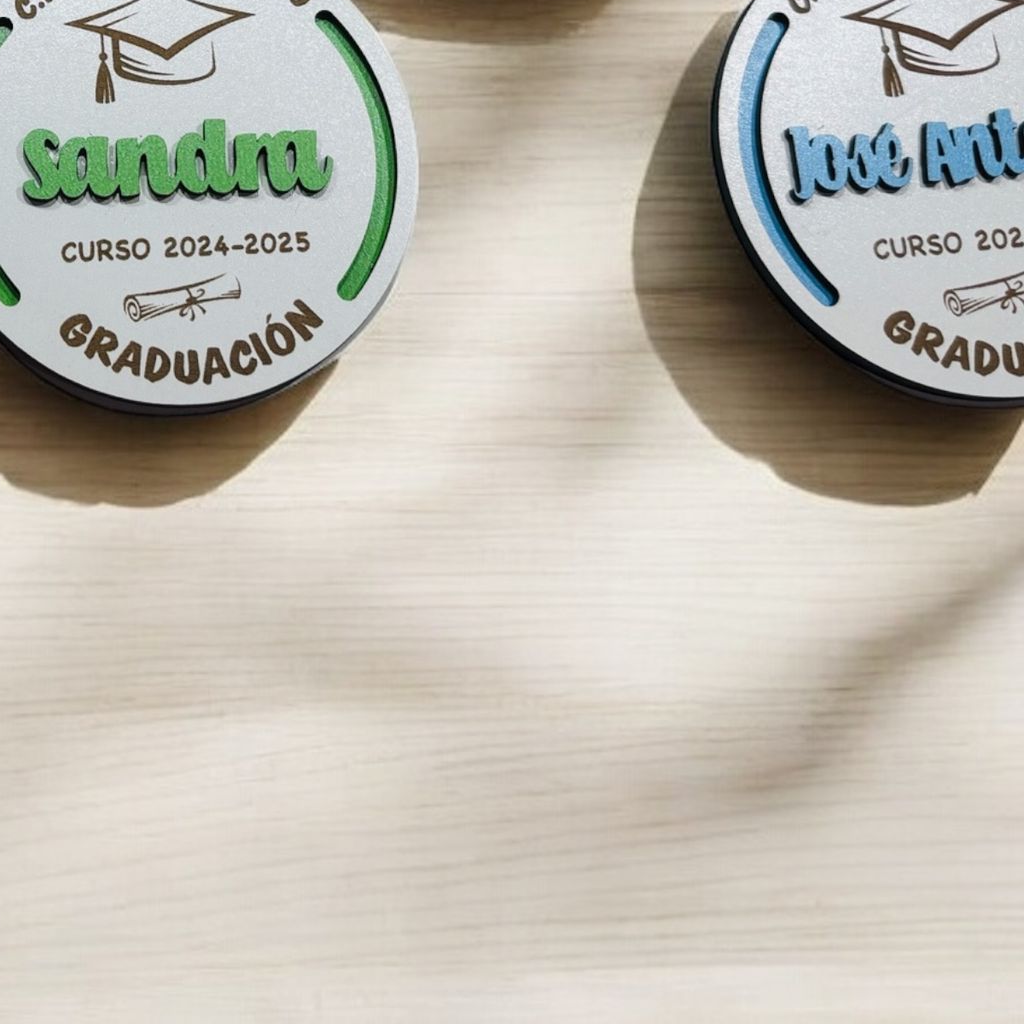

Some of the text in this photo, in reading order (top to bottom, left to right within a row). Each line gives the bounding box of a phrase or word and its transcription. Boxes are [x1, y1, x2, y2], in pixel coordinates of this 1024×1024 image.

[22, 118, 334, 201] Sandra
[786, 107, 1024, 203] José Ant
[61, 231, 311, 263] CURSO 2024-2025
[873, 231, 963, 261] CURSO
[60, 298, 324, 385] GRADUACIÓN
